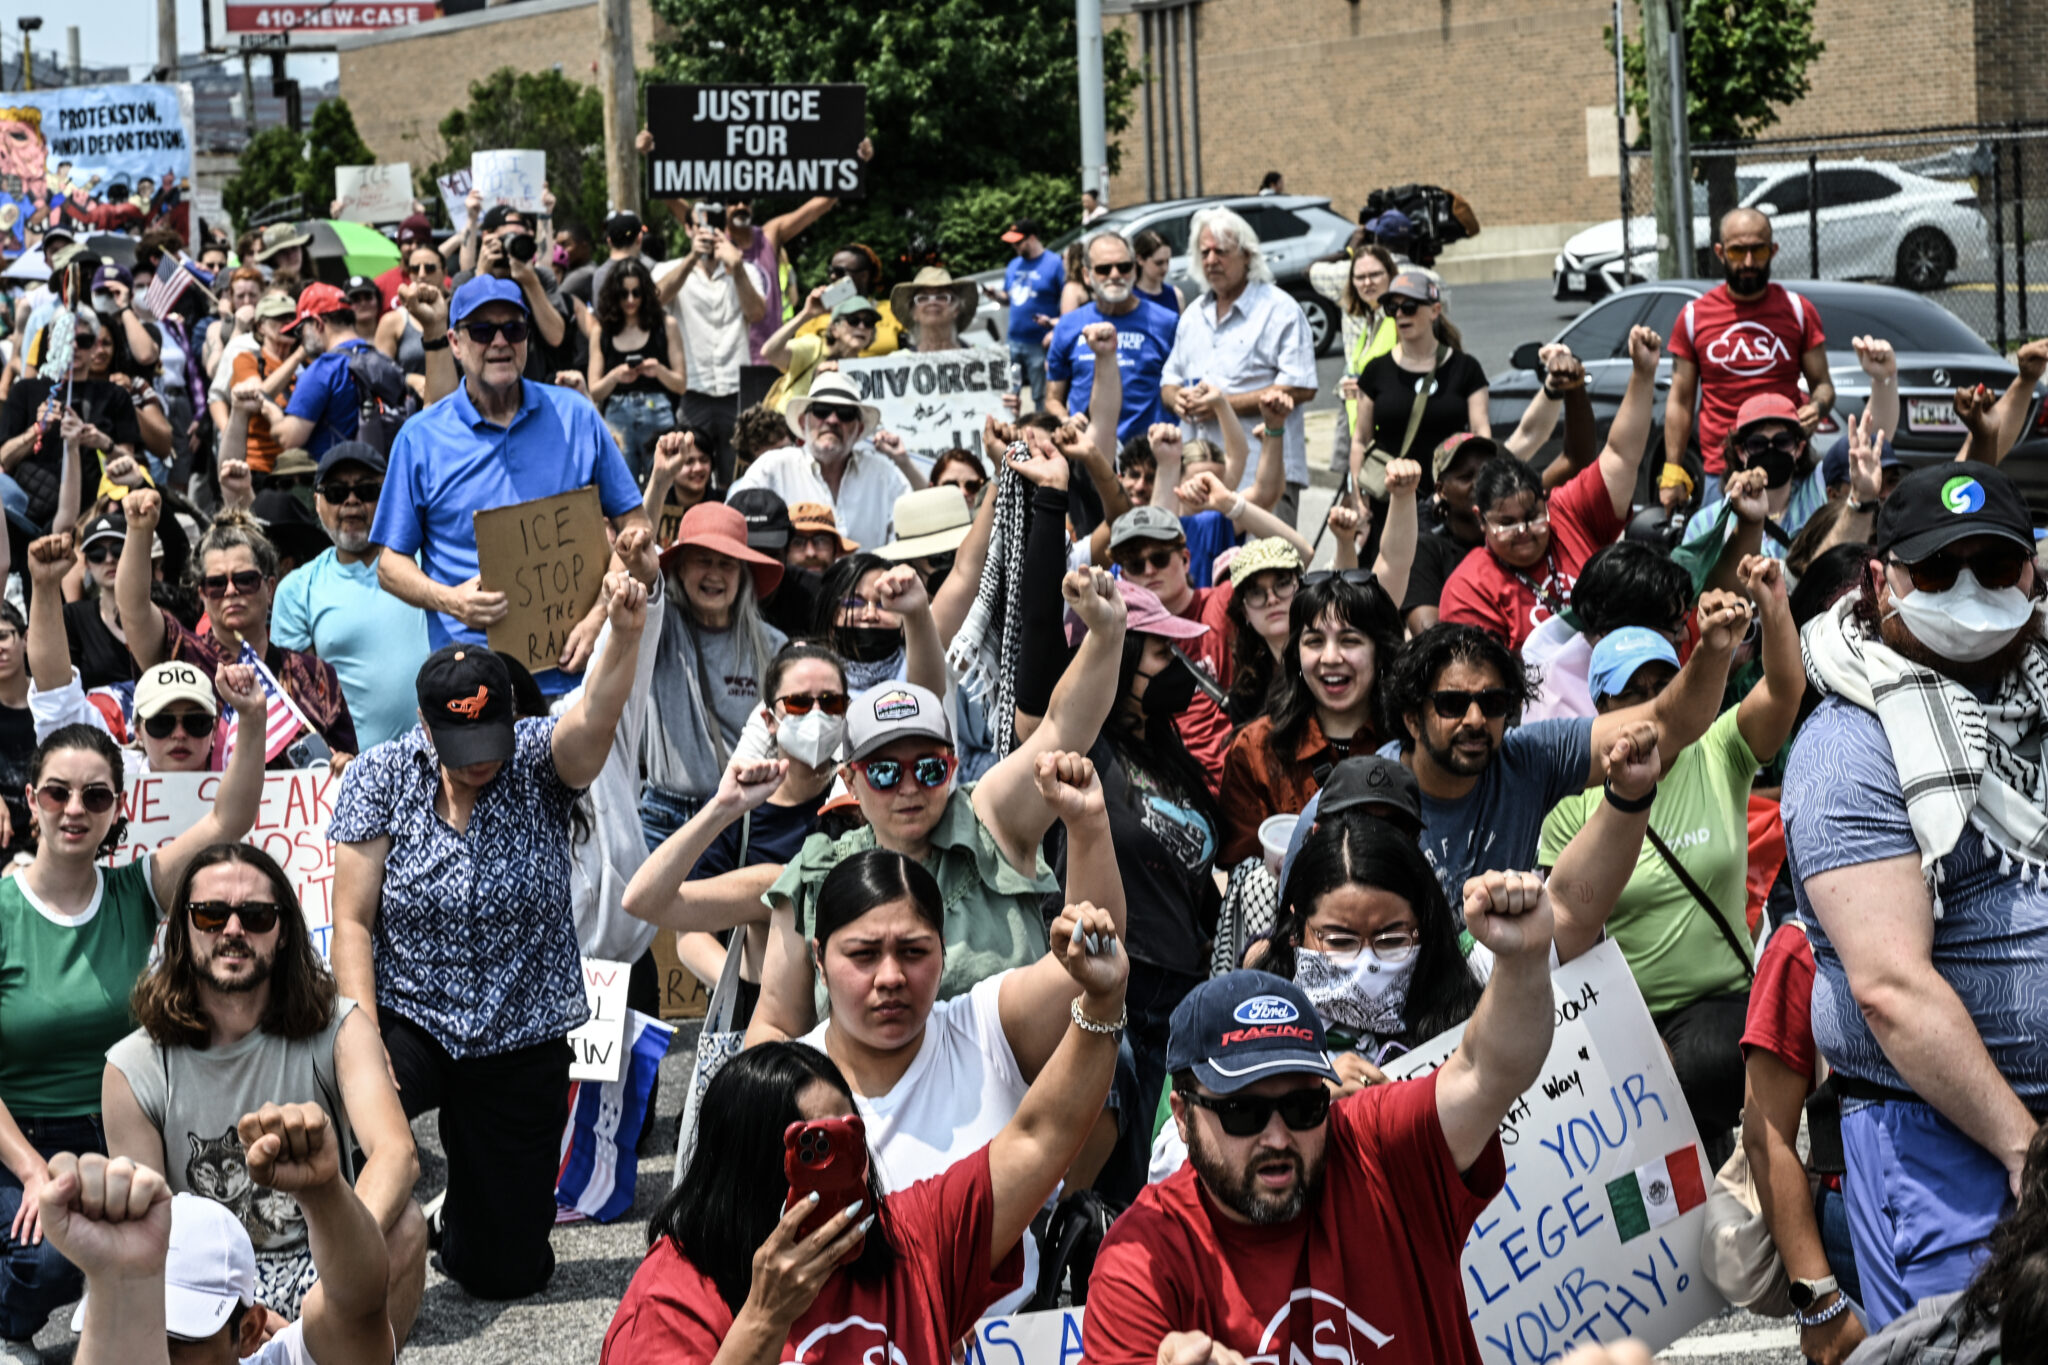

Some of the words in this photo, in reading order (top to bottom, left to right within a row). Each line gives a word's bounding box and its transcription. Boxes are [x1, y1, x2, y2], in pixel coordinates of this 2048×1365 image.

[256, 7, 420, 28] 410-NEW-CASE
[58, 102, 163, 132] PROTEKSYON,
[693, 89, 821, 121] JUSTICE
[726, 124, 788, 157] FOR
[653, 158, 859, 192] IMMIGRANTS
[1706, 336, 1792, 364] CASA
[847, 360, 1009, 400] DIVORCE
[519, 505, 576, 555] ICE
[515, 553, 585, 608] STOP
[542, 600, 575, 624] THE
[1655, 827, 1711, 858] TAND
[1249, 1000, 1289, 1019] Ford
[1221, 1025, 1314, 1047] RACING
[1539, 1072, 1669, 1180] YOUR
[1485, 1266, 1610, 1365] YOUR
